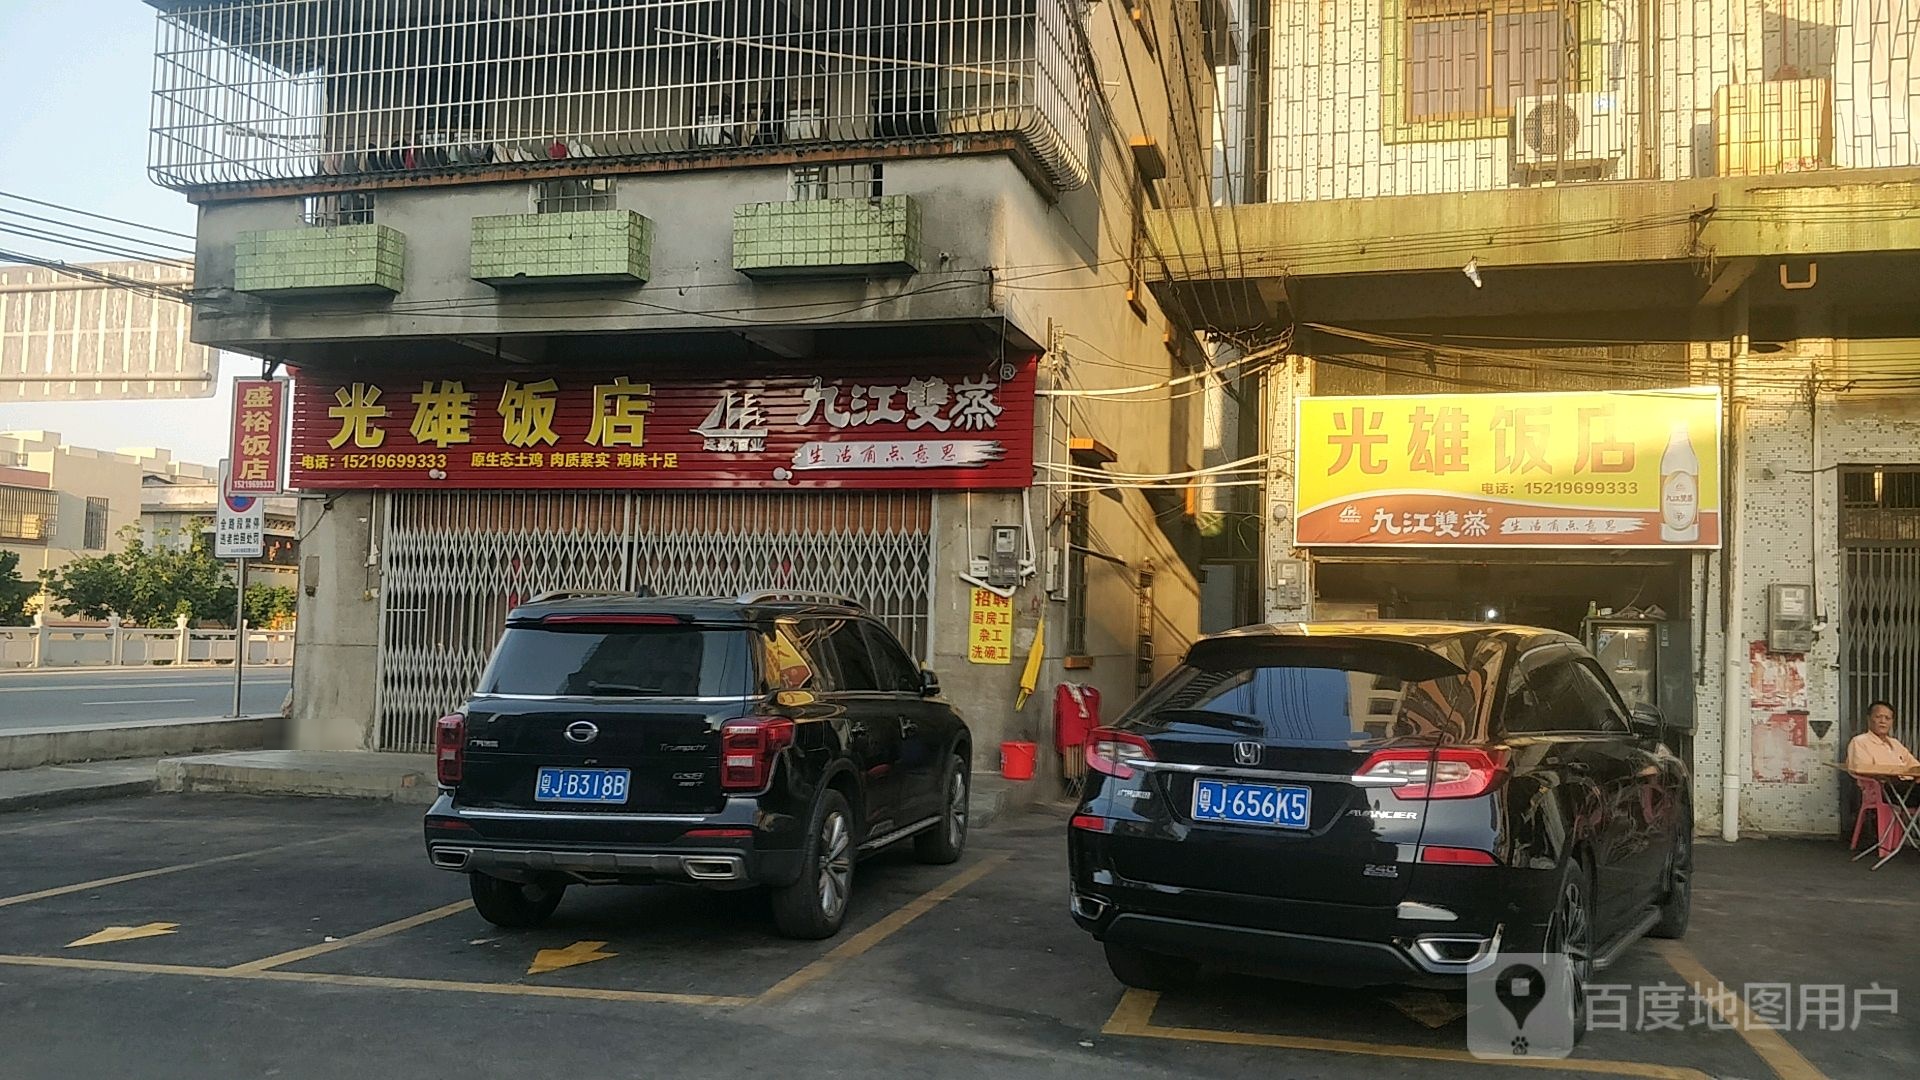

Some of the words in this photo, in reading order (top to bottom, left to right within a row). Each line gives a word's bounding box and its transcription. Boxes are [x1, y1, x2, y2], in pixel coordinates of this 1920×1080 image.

[327, 376, 651, 449] 光雄饭店
[796, 374, 1001, 432] 九江雙蒸
[239, 386, 273, 479] 盛裕饭店
[1328, 404, 1637, 476] 光雄饭店
[471, 452, 543, 468] 原生态土鸡
[550, 452, 610, 468] 肉质紧实
[617, 453, 678, 468] 鸡味十足
[808, 444, 957, 465] 生活有点意思
[1369, 507, 1490, 537] 九江雙蒸
[973, 610, 1009, 624] 厨房工
[979, 628, 1002, 642] 杂工
[971, 645, 1009, 660] 洗碗工
[1346, 809, 1417, 820] AVANCIER
